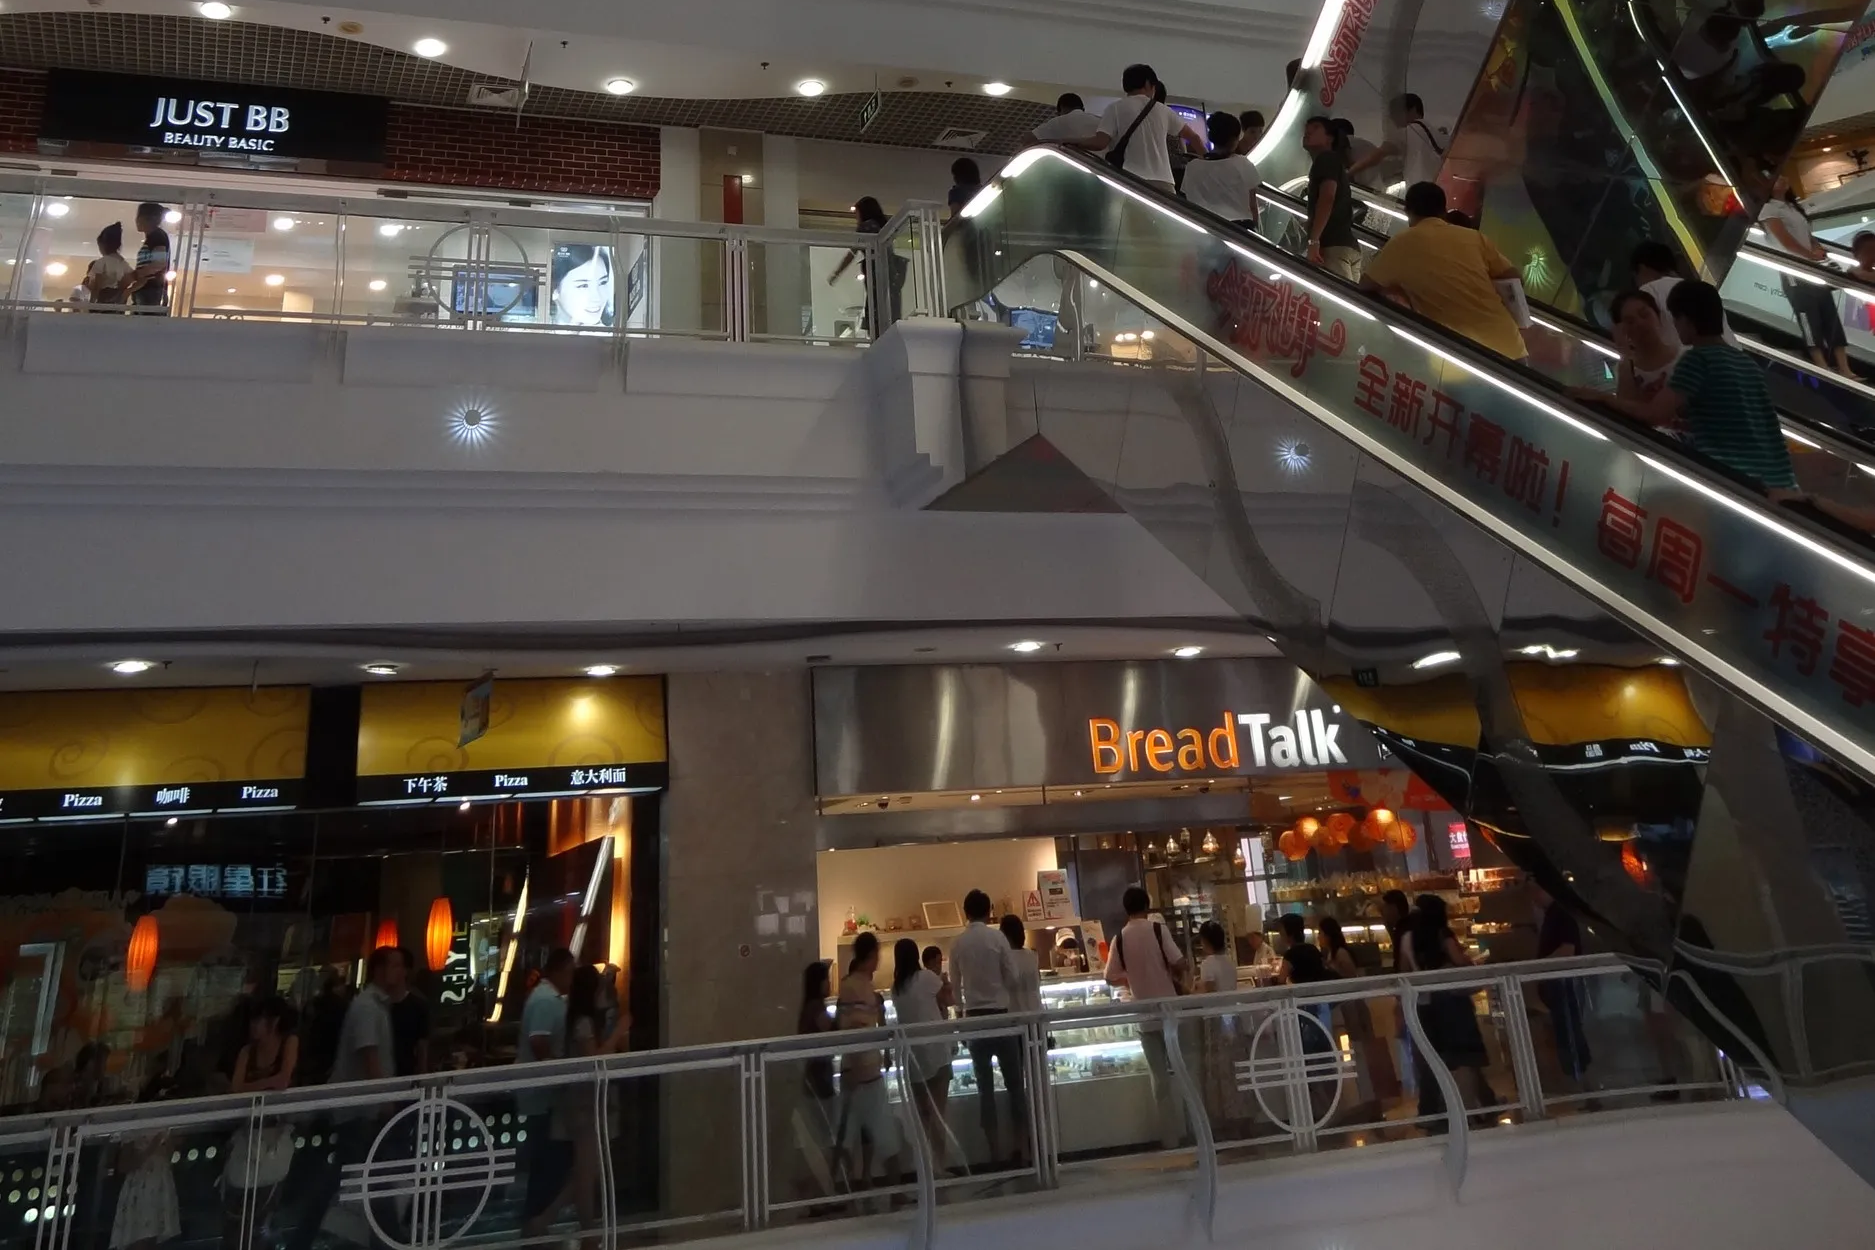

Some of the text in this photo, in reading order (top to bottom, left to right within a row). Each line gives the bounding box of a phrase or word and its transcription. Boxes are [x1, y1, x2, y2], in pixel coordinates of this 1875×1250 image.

[150, 96, 290, 133] JUST BB
[163, 131, 275, 151] BEAUTY BASIC
[1089, 711, 1348, 775] BreadTalk
[402, 776, 449, 794] 下午茶
[493, 772, 529, 788] Pizza
[569, 767, 627, 786] 意大利面
[62, 793, 103, 809] Pizza
[155, 787, 191, 805] 咖啡
[241, 784, 279, 800] Pizza
